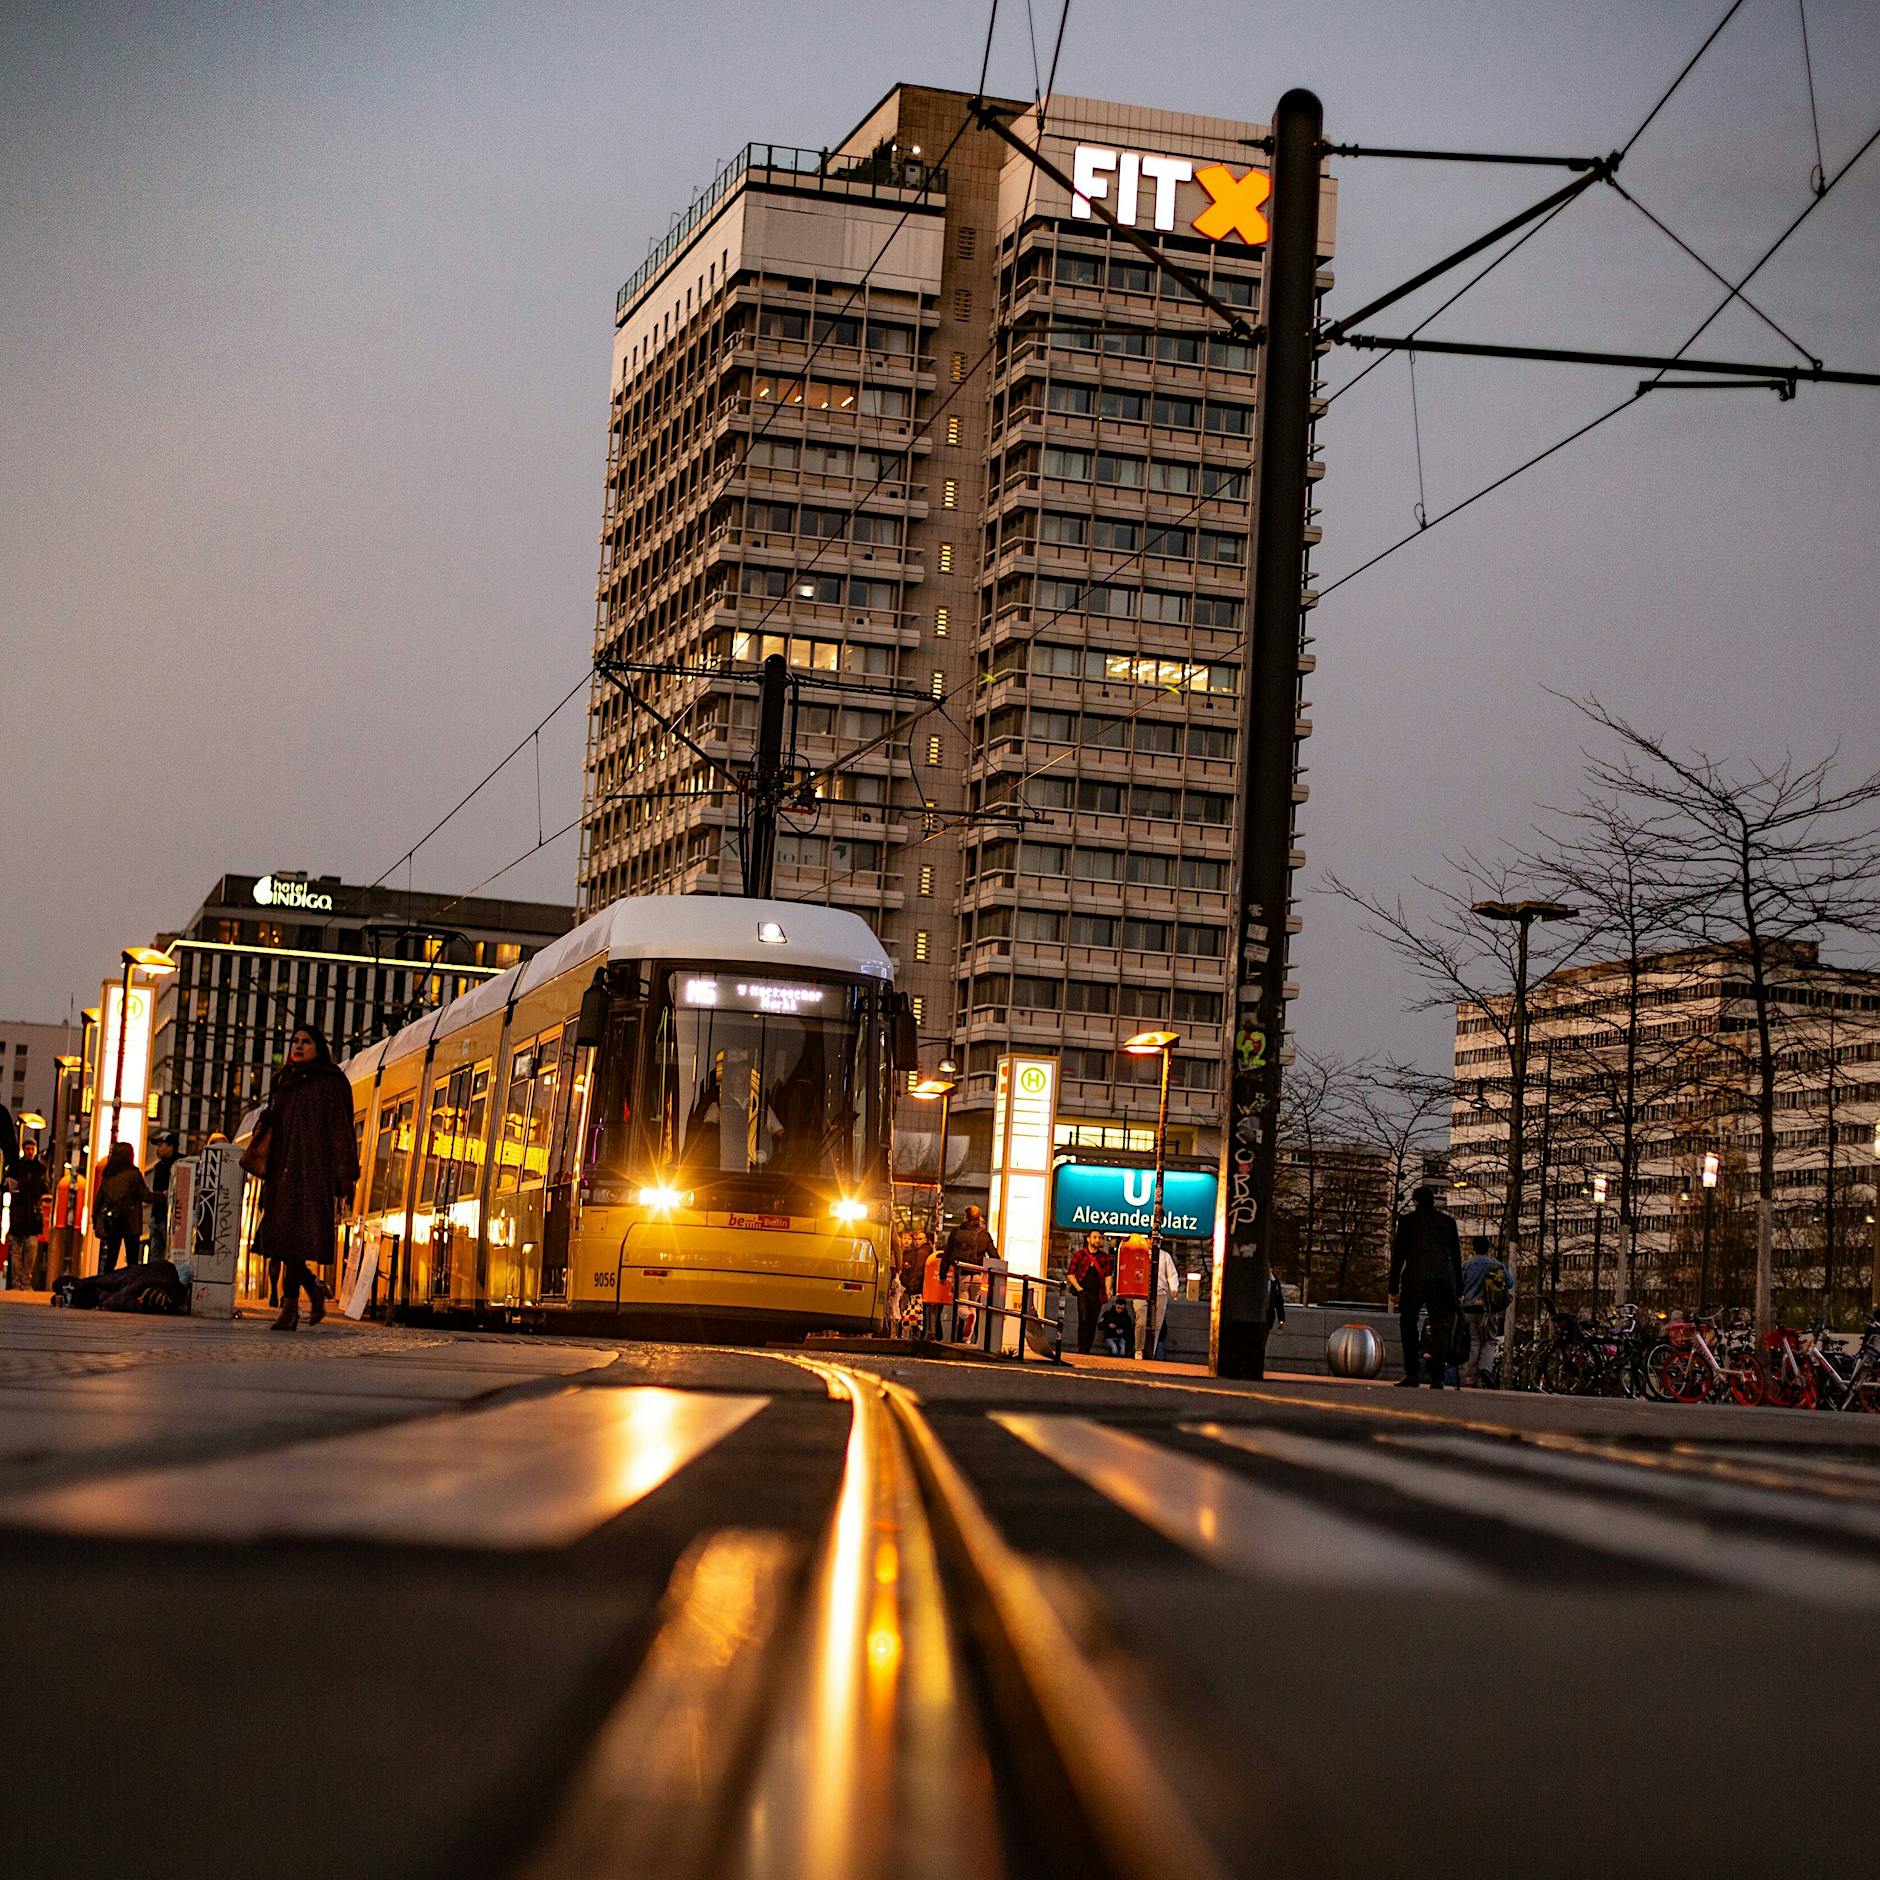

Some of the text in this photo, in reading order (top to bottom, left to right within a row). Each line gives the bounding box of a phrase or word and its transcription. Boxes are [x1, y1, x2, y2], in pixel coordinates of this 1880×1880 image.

[273, 879, 308, 895] hotel
[272, 891, 333, 911] INDIGO
[1123, 1170, 1151, 1207] U
[764, 1217, 788, 1228] Berlin
[594, 1272, 615, 1287] 9056
